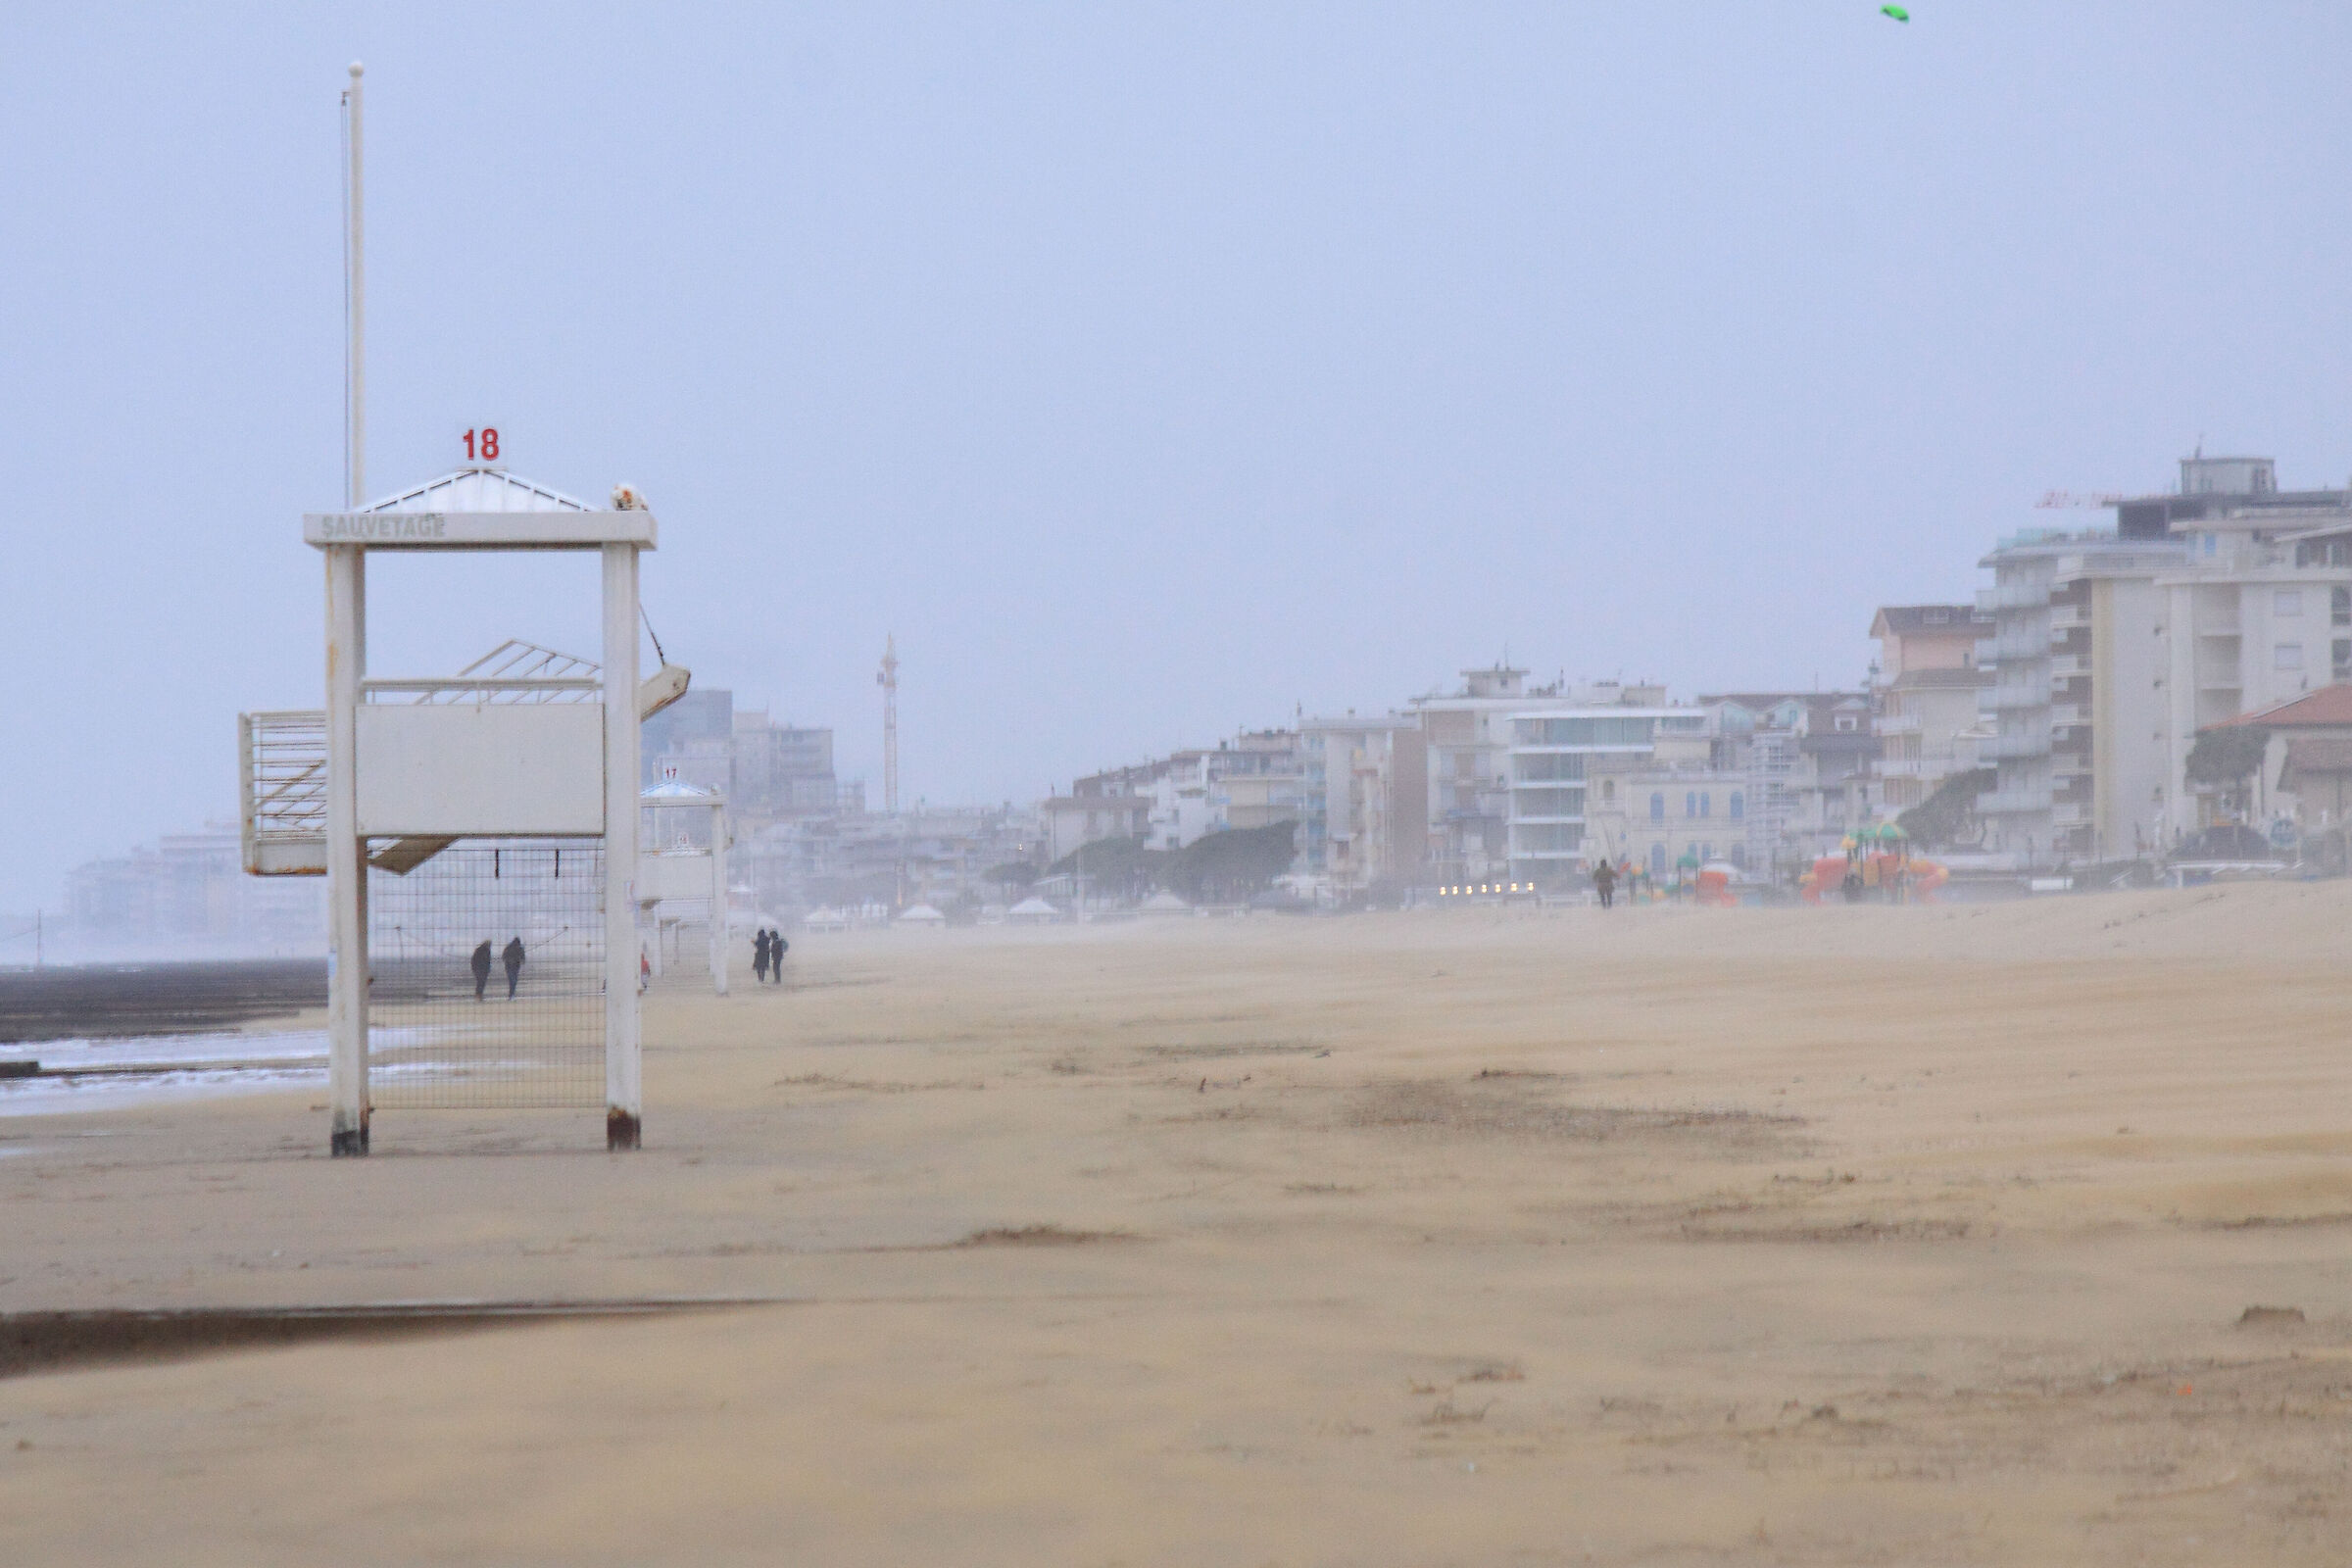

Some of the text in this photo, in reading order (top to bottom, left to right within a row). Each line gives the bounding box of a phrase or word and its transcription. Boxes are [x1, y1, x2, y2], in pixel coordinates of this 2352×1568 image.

[463, 428, 499, 461] 18
[321, 514, 446, 537] SAUVETAGE
[666, 768, 677, 778] 17
